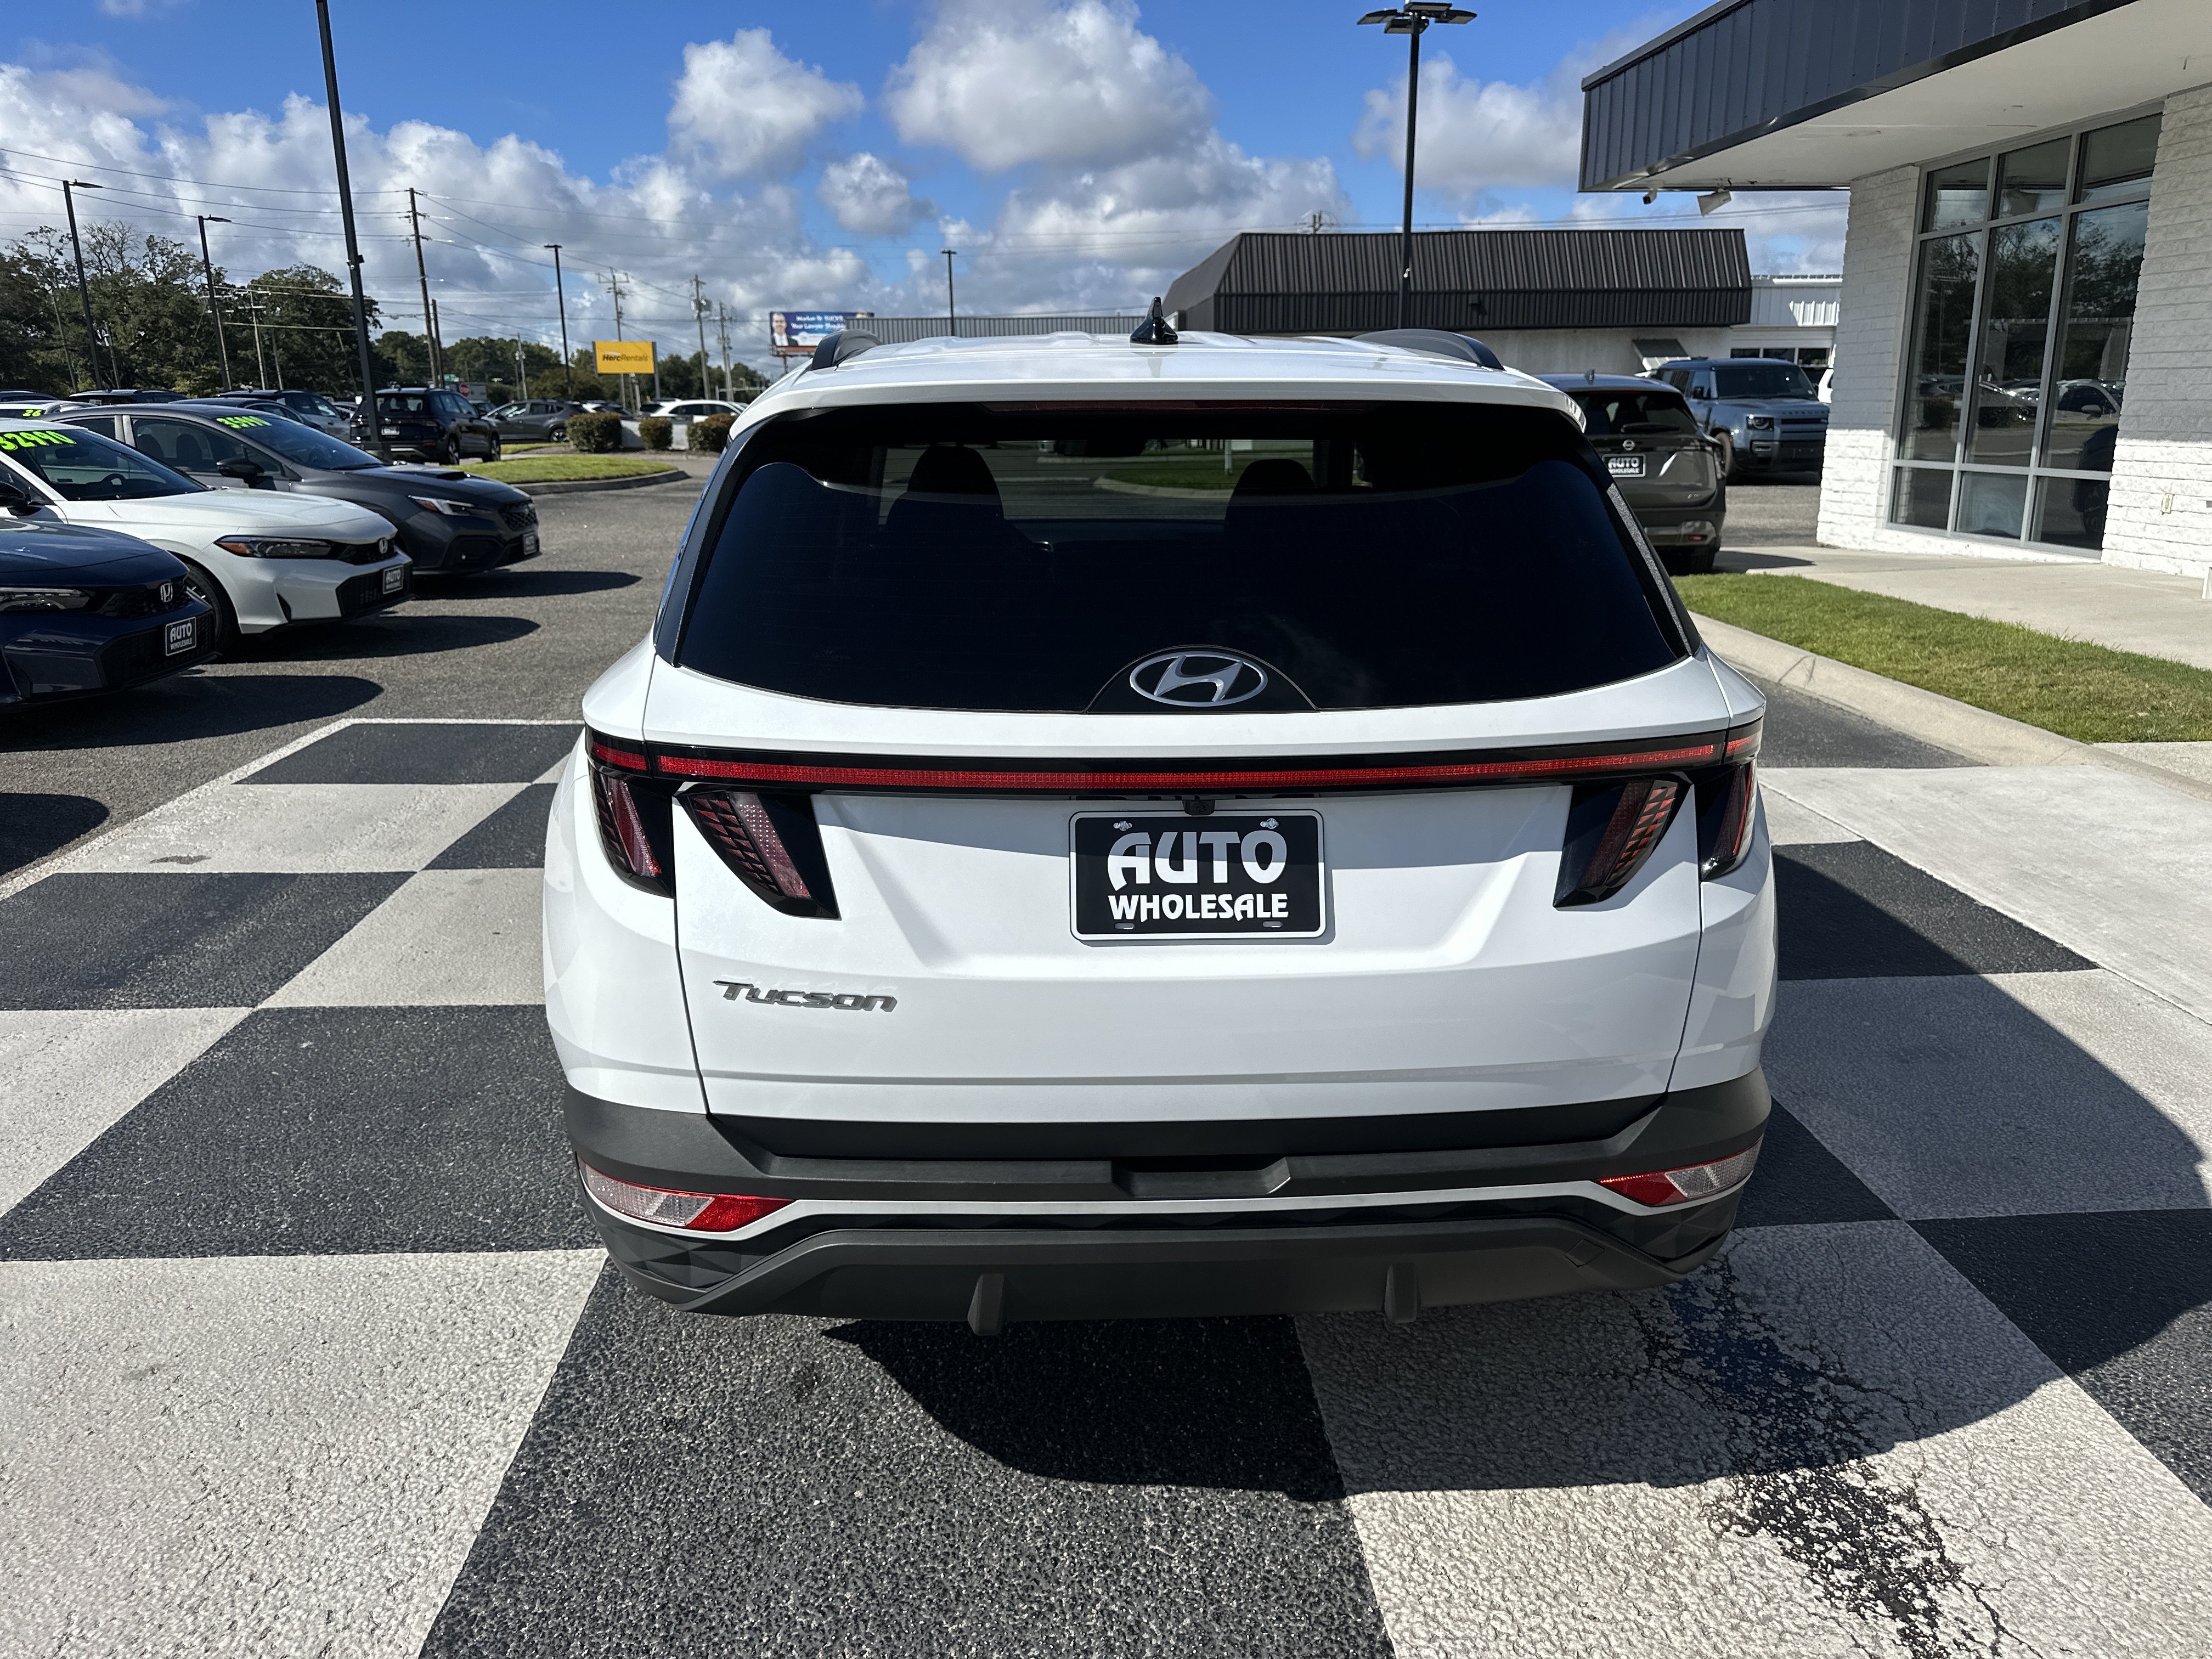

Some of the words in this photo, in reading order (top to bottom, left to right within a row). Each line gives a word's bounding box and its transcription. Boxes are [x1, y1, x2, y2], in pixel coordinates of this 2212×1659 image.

[1608, 457, 1639, 469] AUTO
[170, 623, 192, 642] AUTO
[1107, 830, 1287, 891] AUTO
[1108, 893, 1289, 923] WHOLESALE
[713, 979, 898, 1012] Tucson
